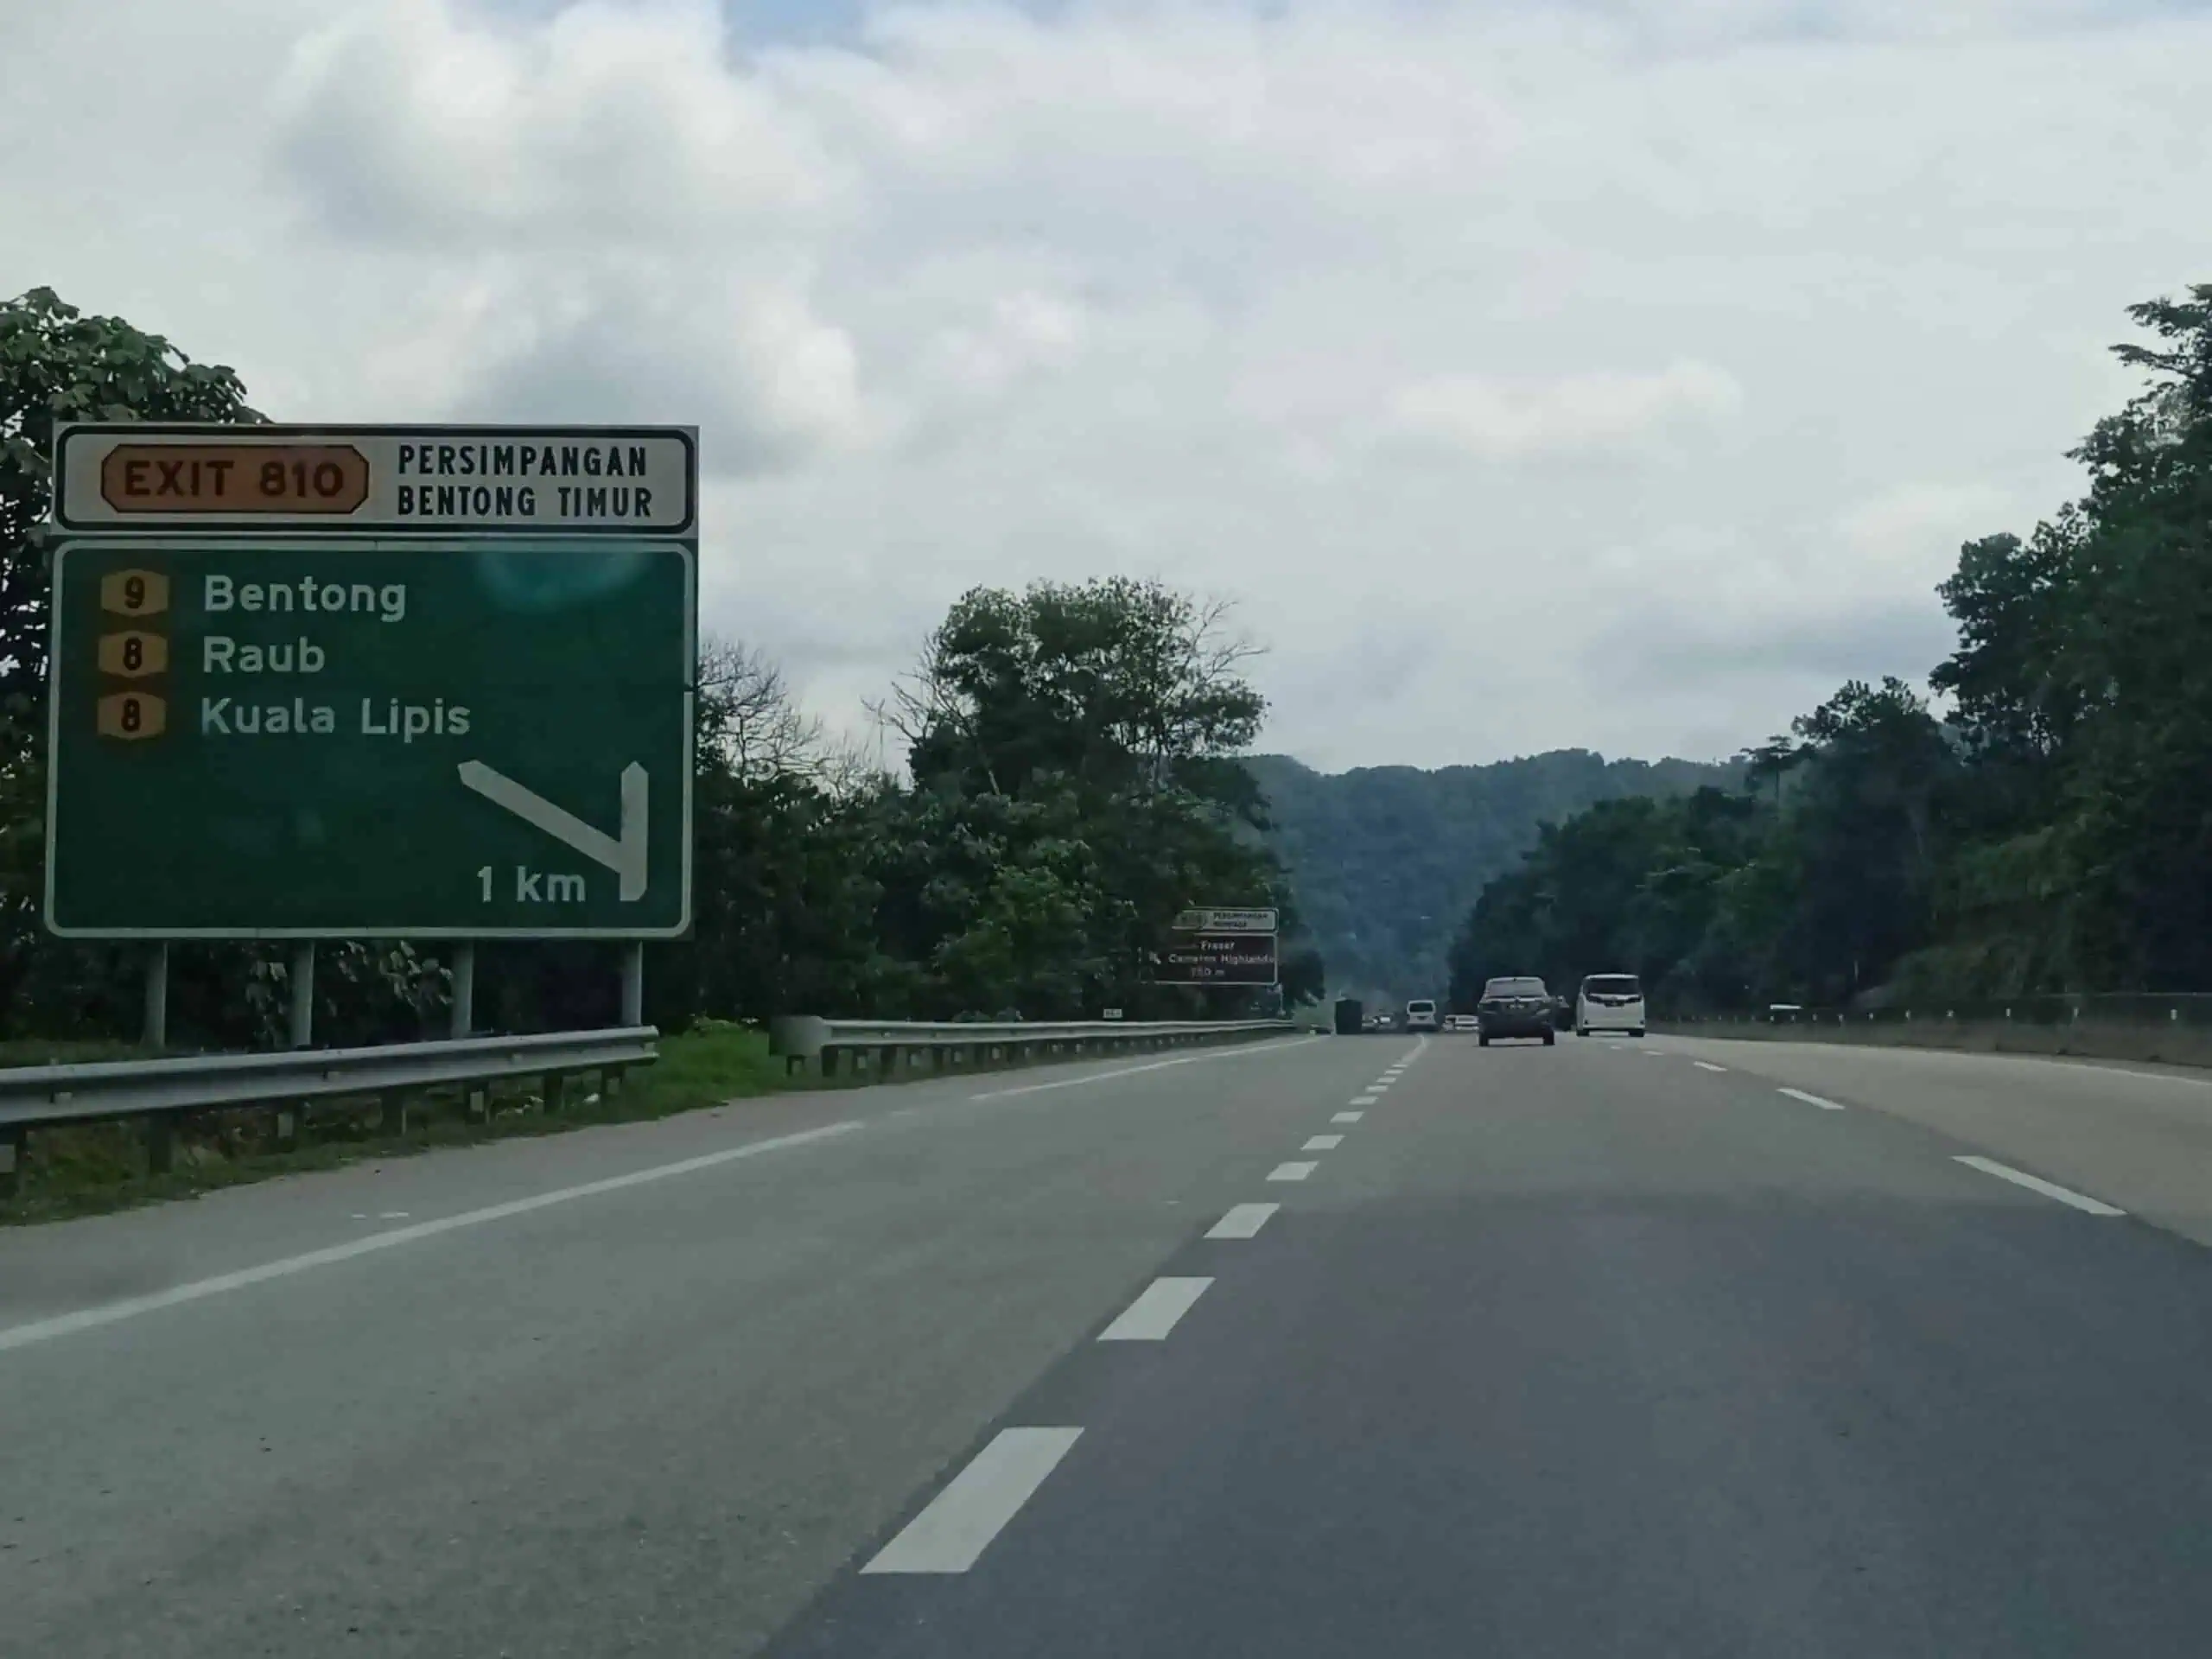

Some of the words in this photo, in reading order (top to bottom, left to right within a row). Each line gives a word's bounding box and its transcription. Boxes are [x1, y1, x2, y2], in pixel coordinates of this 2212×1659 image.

[124, 460, 232, 497] EXIT
[258, 460, 345, 497] 810
[397, 443, 647, 477] PERSIMPANGAN
[397, 484, 535, 518] BENTONG
[556, 486, 652, 518] TIMUR
[124, 576, 145, 610] 9
[203, 575, 407, 623] Bentong
[122, 638, 143, 671] 8
[202, 635, 326, 674] Raub
[120, 698, 141, 732] 8
[200, 697, 335, 736] Kuala
[359, 697, 471, 743] Lipis
[476, 865, 493, 903] 1
[516, 865, 587, 903] km
